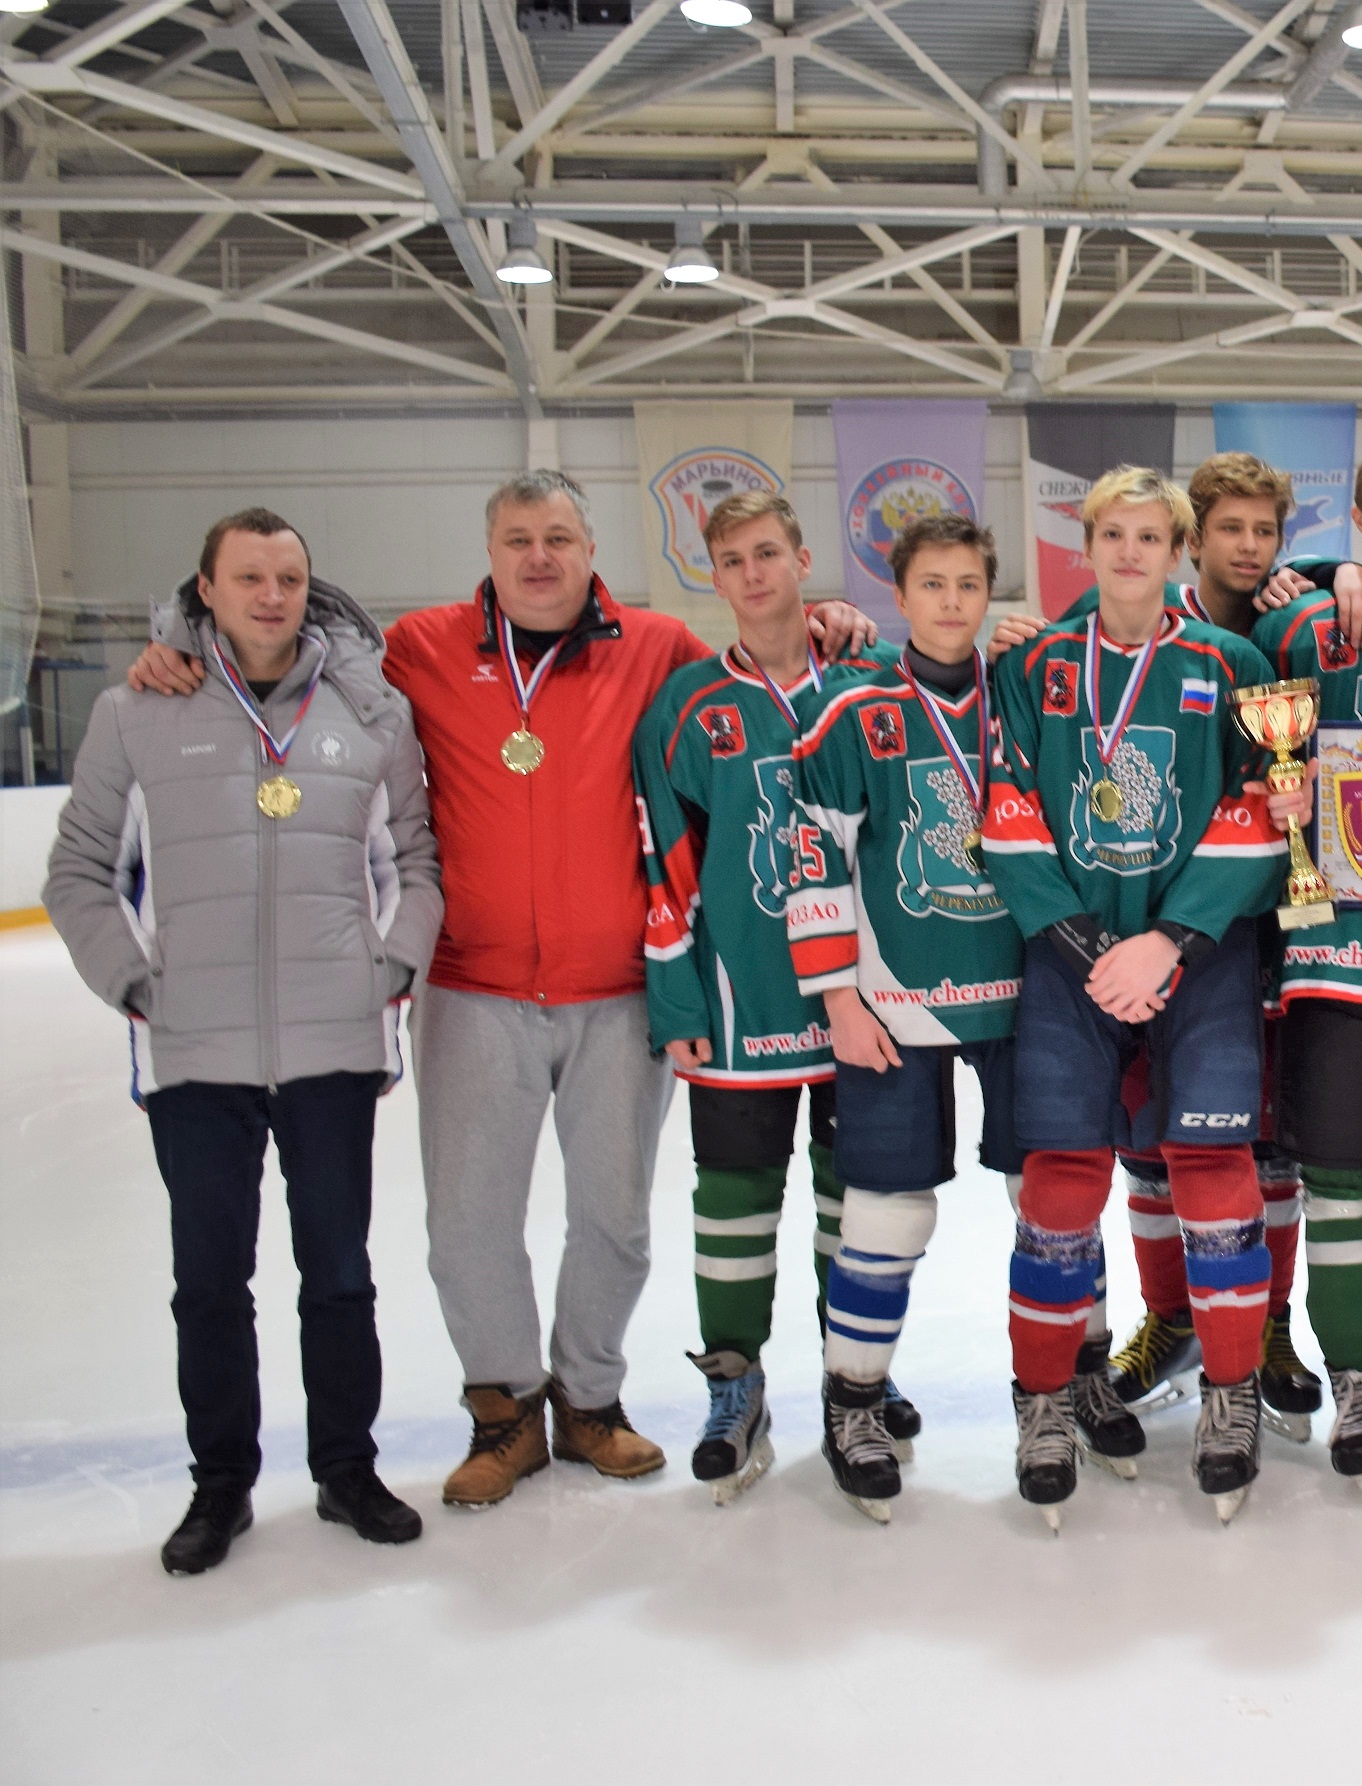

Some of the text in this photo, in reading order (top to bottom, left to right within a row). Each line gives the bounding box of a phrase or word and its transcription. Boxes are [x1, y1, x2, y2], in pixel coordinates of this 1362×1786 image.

[670, 461, 762, 493] МАРЬИНО
[1038, 481, 1094, 497] СНЕЖН
[1179, 1112, 1252, 1128] CCM
